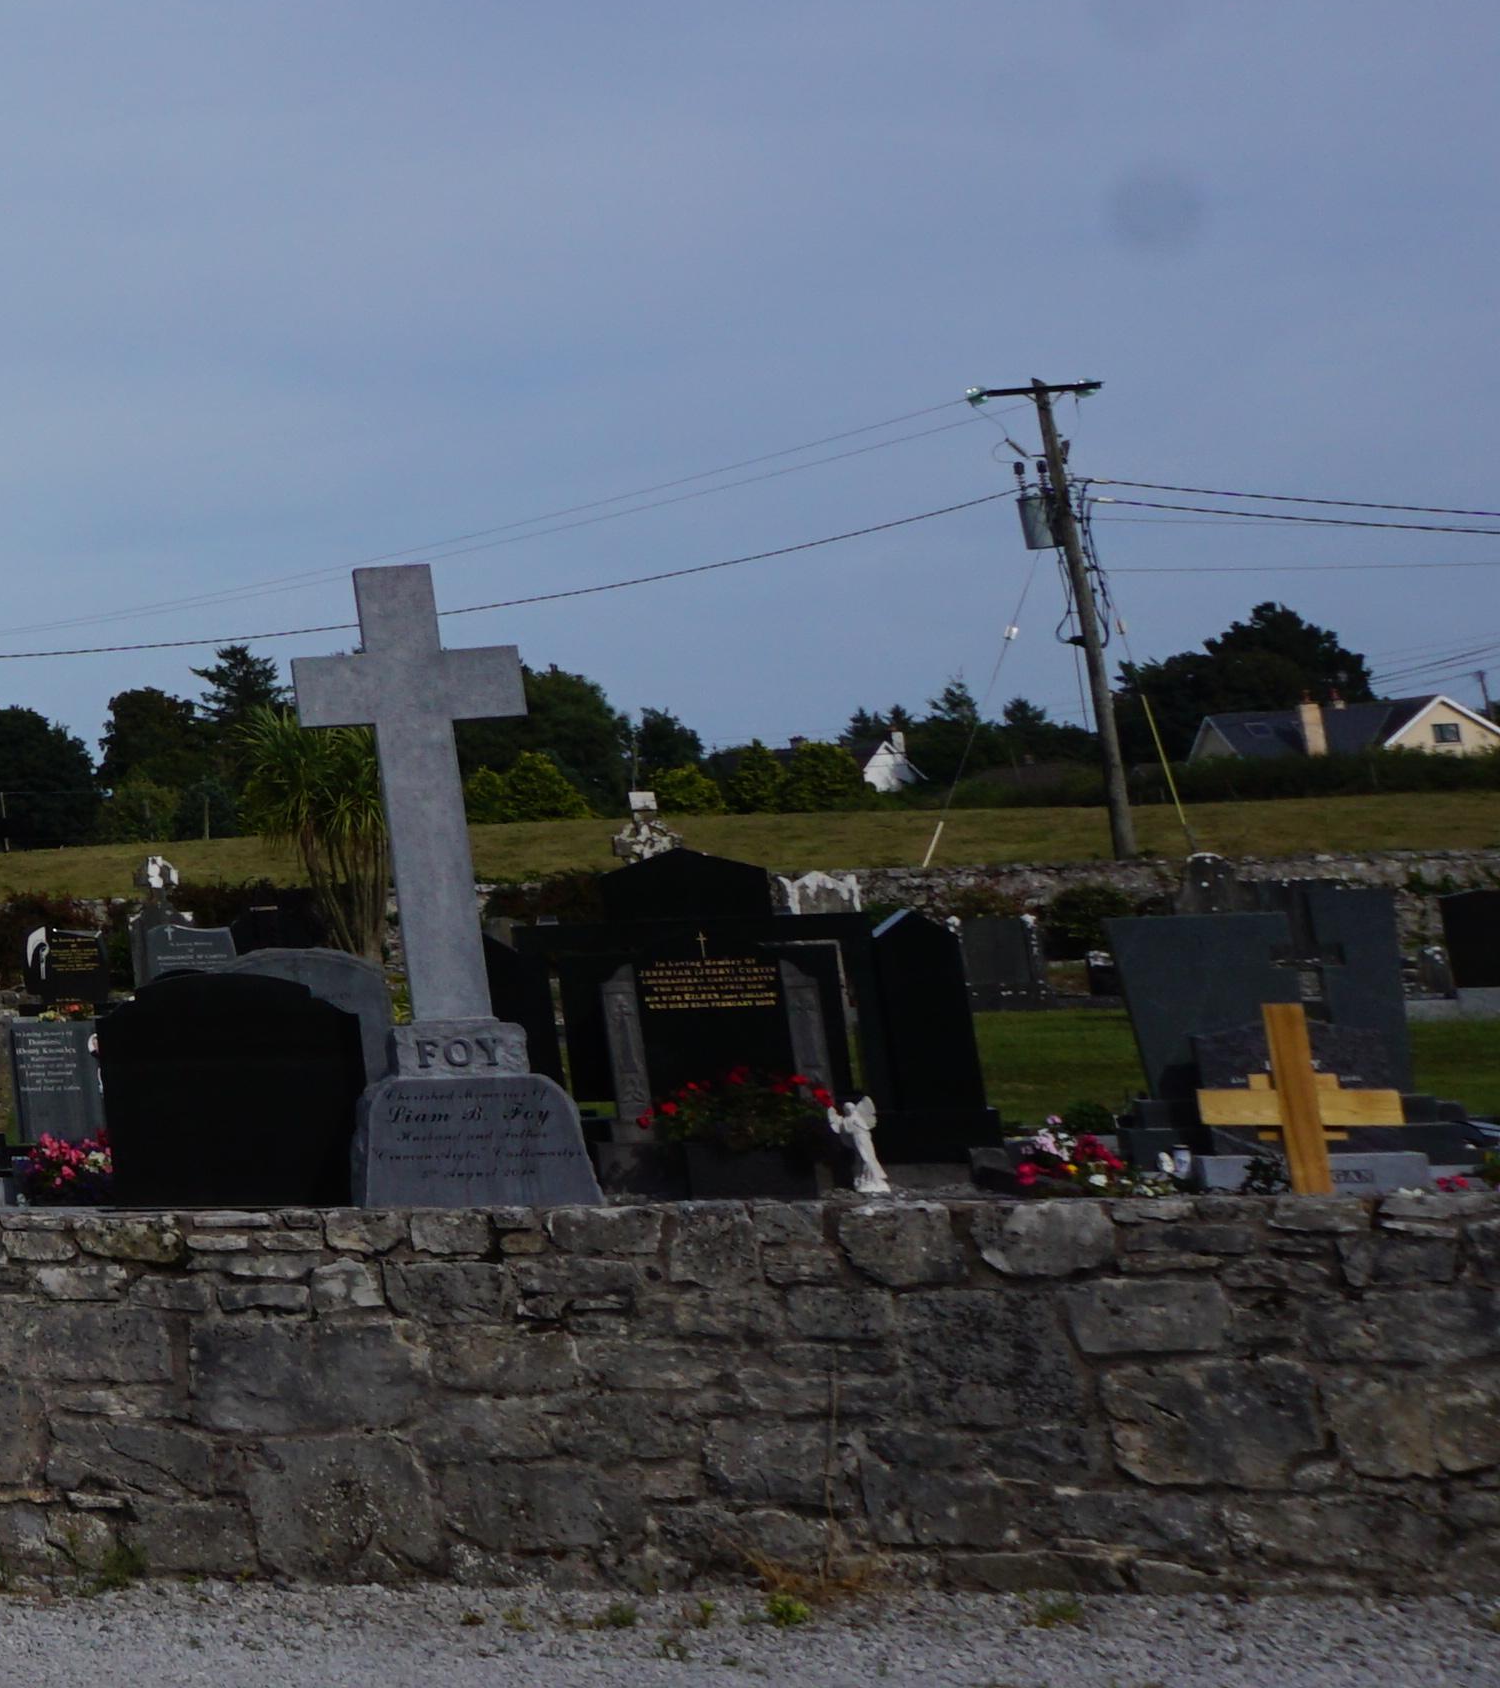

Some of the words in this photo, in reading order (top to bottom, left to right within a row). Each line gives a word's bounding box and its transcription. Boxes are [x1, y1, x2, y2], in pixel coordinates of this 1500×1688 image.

[668, 959, 701, 968] Loving
[416, 1037, 501, 1069] FOY
[387, 1105, 451, 1124] Liam
[503, 1102, 551, 1125] Foy
